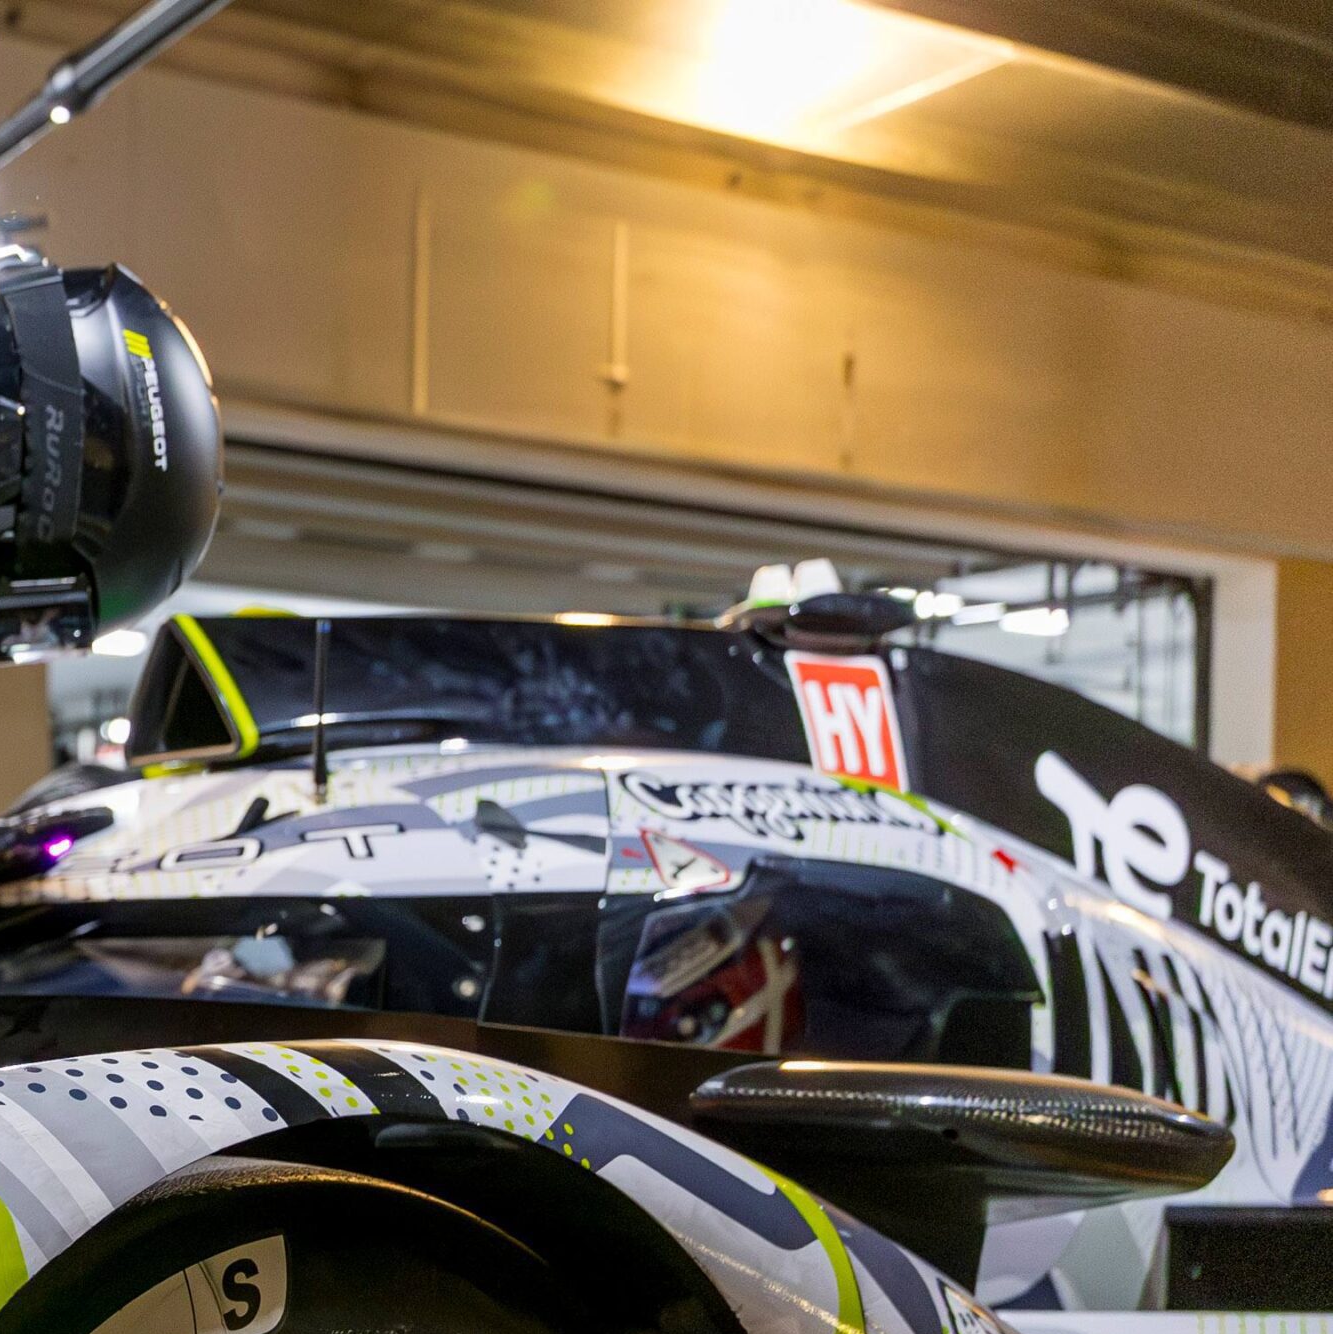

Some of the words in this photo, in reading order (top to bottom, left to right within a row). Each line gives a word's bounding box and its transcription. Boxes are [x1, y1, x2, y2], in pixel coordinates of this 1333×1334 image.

[140, 356, 168, 473] PEUGEOT
[802, 679, 886, 778] HY
[1193, 850, 1333, 1000] TotalE
[221, 1257, 262, 1332] S
